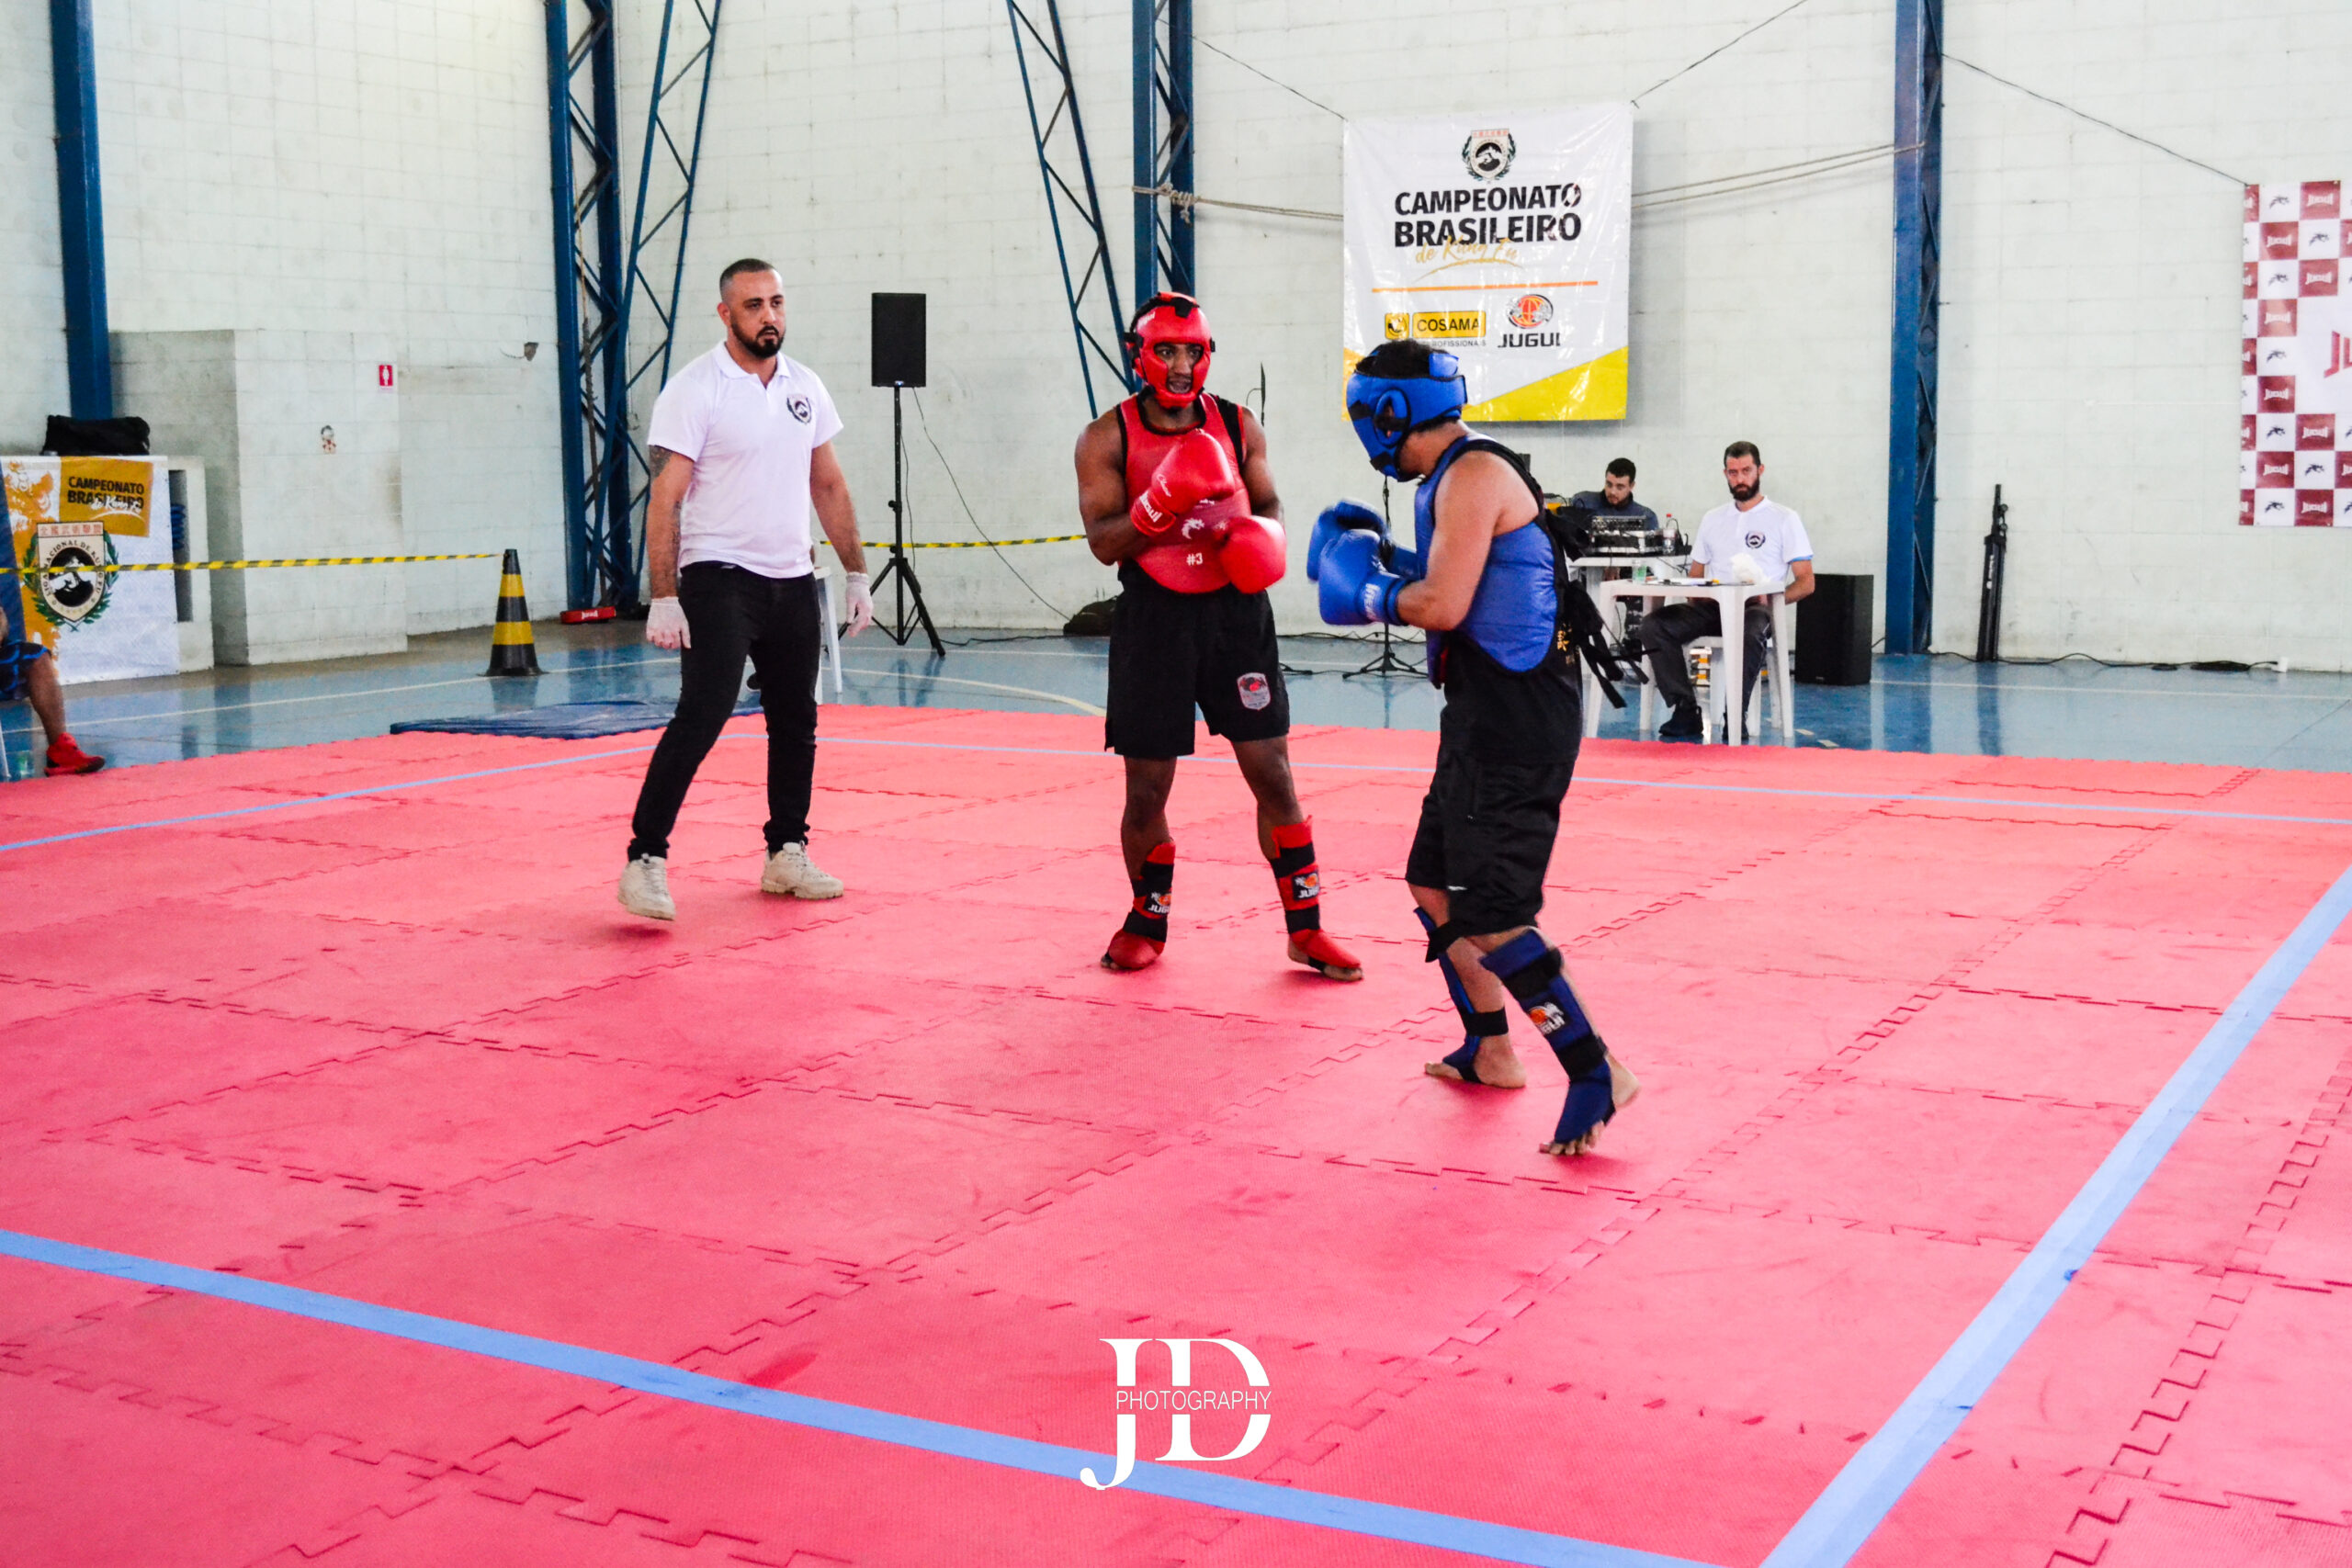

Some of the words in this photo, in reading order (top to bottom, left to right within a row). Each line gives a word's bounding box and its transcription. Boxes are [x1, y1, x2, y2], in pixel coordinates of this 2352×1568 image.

[1395, 183, 1581, 215] CAMPEONATO
[1395, 212, 1581, 247] BRASILEIRO
[1416, 243, 1437, 264] de
[1442, 235, 1488, 262] Kung
[1417, 318, 1480, 332] COSAMA
[1430, 339, 1487, 347] ROFISSIONAS
[1498, 333, 1561, 348] JUGUI
[68, 476, 144, 495] CAMPEONATO
[80, 542, 91, 552] DE
[1186, 552, 1204, 566] #3
[1148, 904, 1170, 914] JUG
